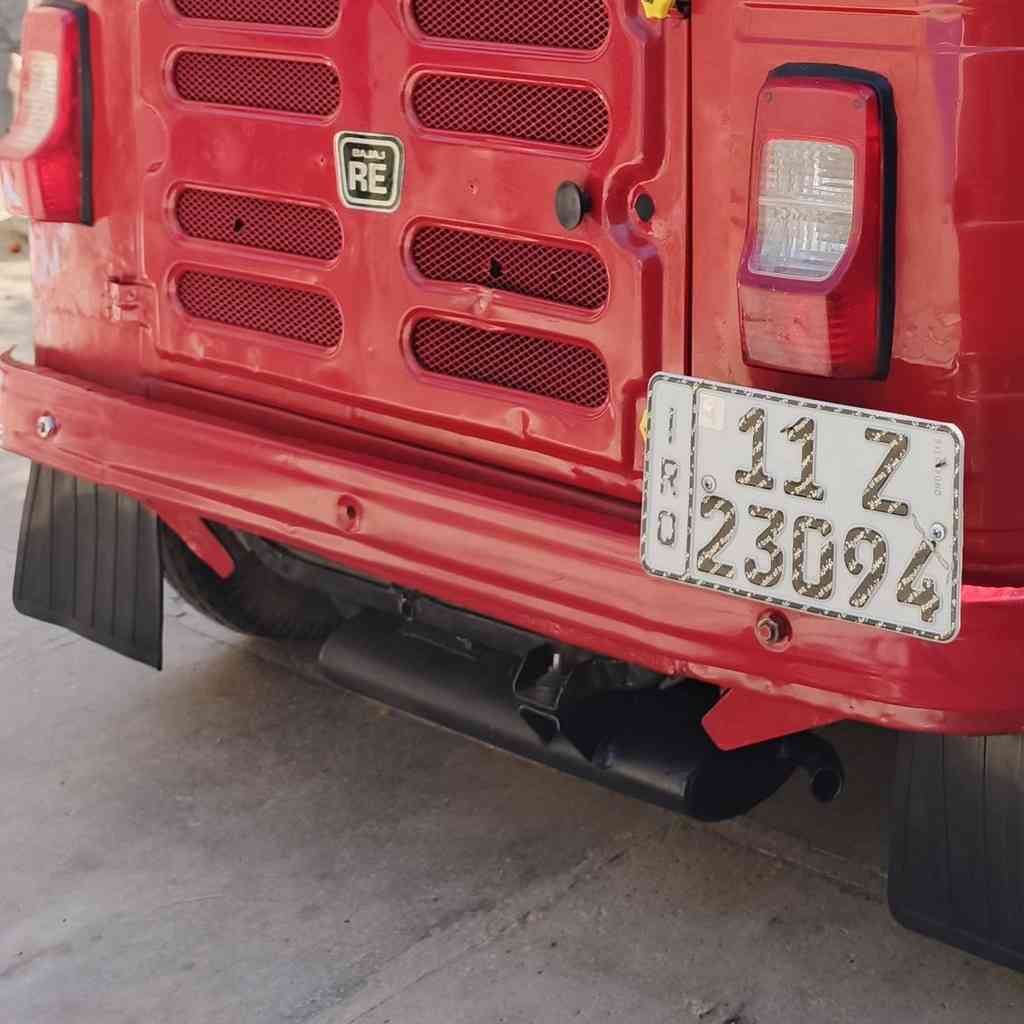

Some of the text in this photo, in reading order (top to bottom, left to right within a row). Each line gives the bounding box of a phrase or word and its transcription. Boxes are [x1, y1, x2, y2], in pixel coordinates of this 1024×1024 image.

[348, 161, 387, 194] RE
[735, 406, 824, 501] 11
[862, 427, 909, 516] Z
[696, 495, 941, 623] 23094
